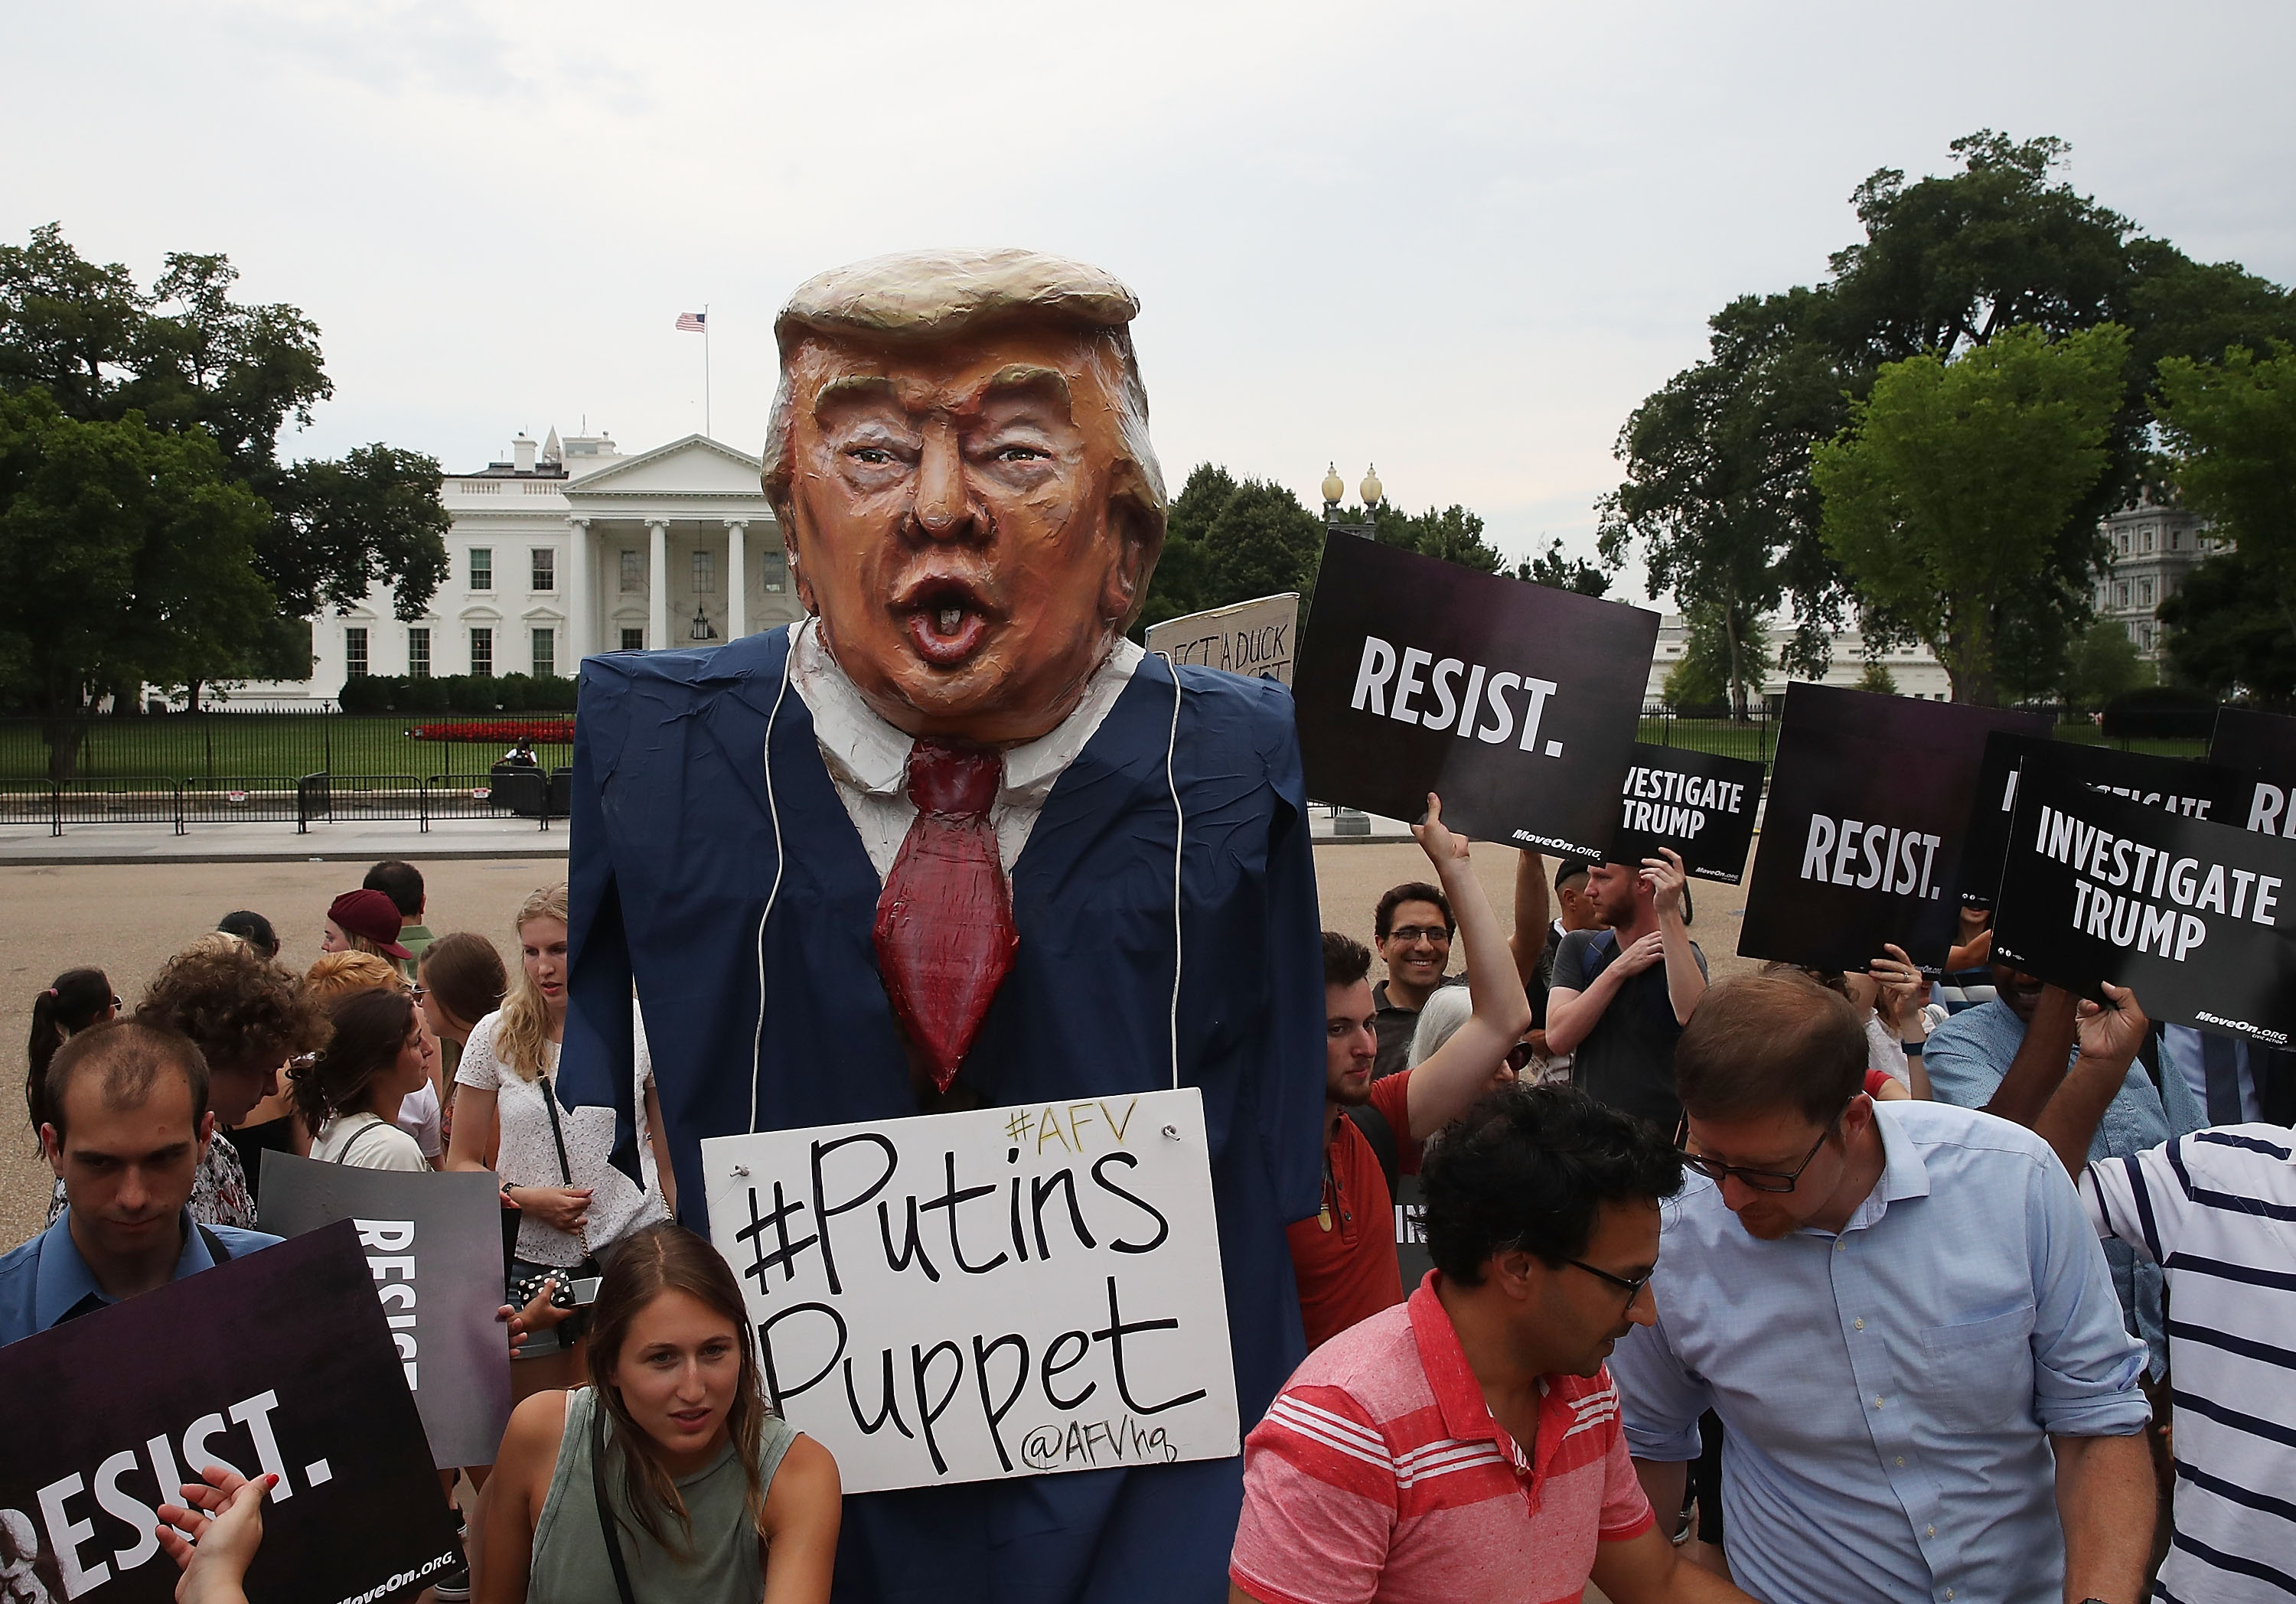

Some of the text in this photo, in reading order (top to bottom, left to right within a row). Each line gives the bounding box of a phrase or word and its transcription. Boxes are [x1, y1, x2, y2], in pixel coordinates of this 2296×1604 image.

[1236, 624, 1288, 670] DUCK
[1351, 636, 1564, 758] RESIST.
[1623, 799, 1705, 839] TRUMP
[1801, 813, 1941, 900] RESIST.
[2036, 805, 2282, 926] INVESTIGATE
[2073, 879, 2206, 962] TRUMP
[1004, 1097, 1138, 1155] #AFV
[736, 1133, 1169, 1295] #Putins
[758, 1276, 1207, 1475] Puppet
